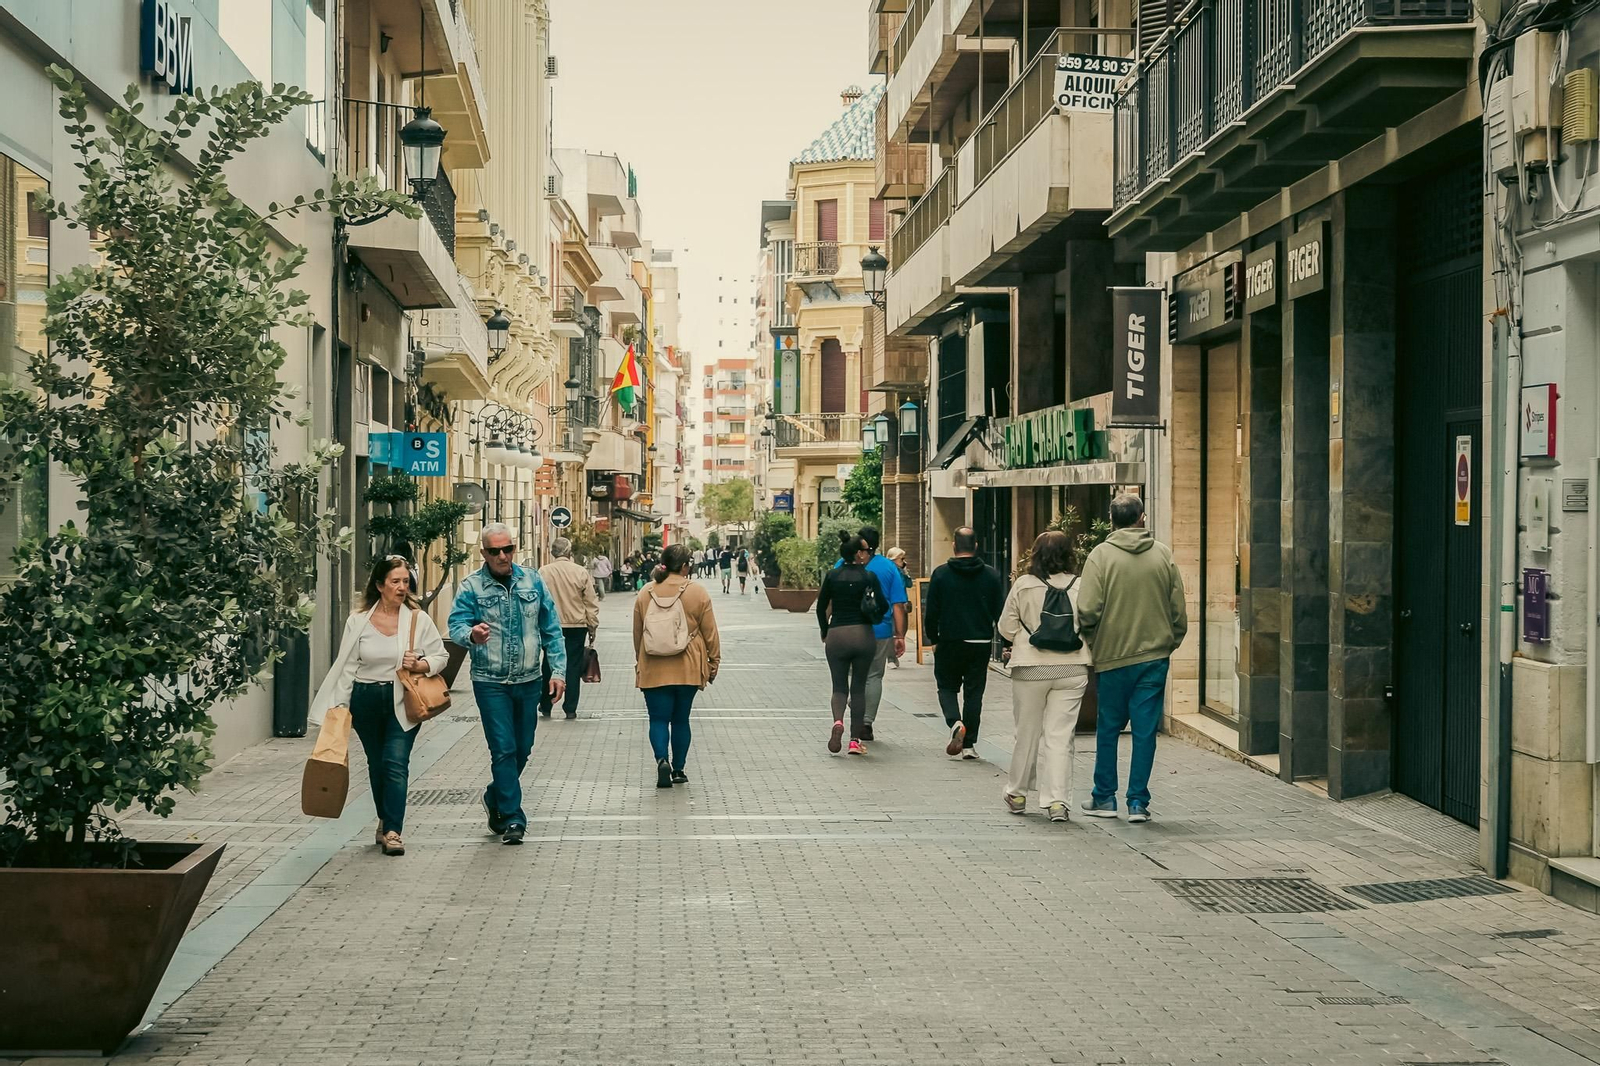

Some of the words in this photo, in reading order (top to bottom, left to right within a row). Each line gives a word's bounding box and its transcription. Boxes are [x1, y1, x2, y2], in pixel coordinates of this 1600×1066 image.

[154, 0, 195, 97] BBVA
[1059, 56, 1082, 69] 959
[1084, 58, 1100, 71] 24
[1102, 60, 1118, 73] 90
[1245, 258, 1274, 299] TIGER
[1287, 240, 1319, 284] TIGER
[1189, 289, 1210, 323] TIGER
[1126, 312, 1146, 400] TIGER
[411, 461, 439, 472] ATM
[425, 440, 440, 458] S
